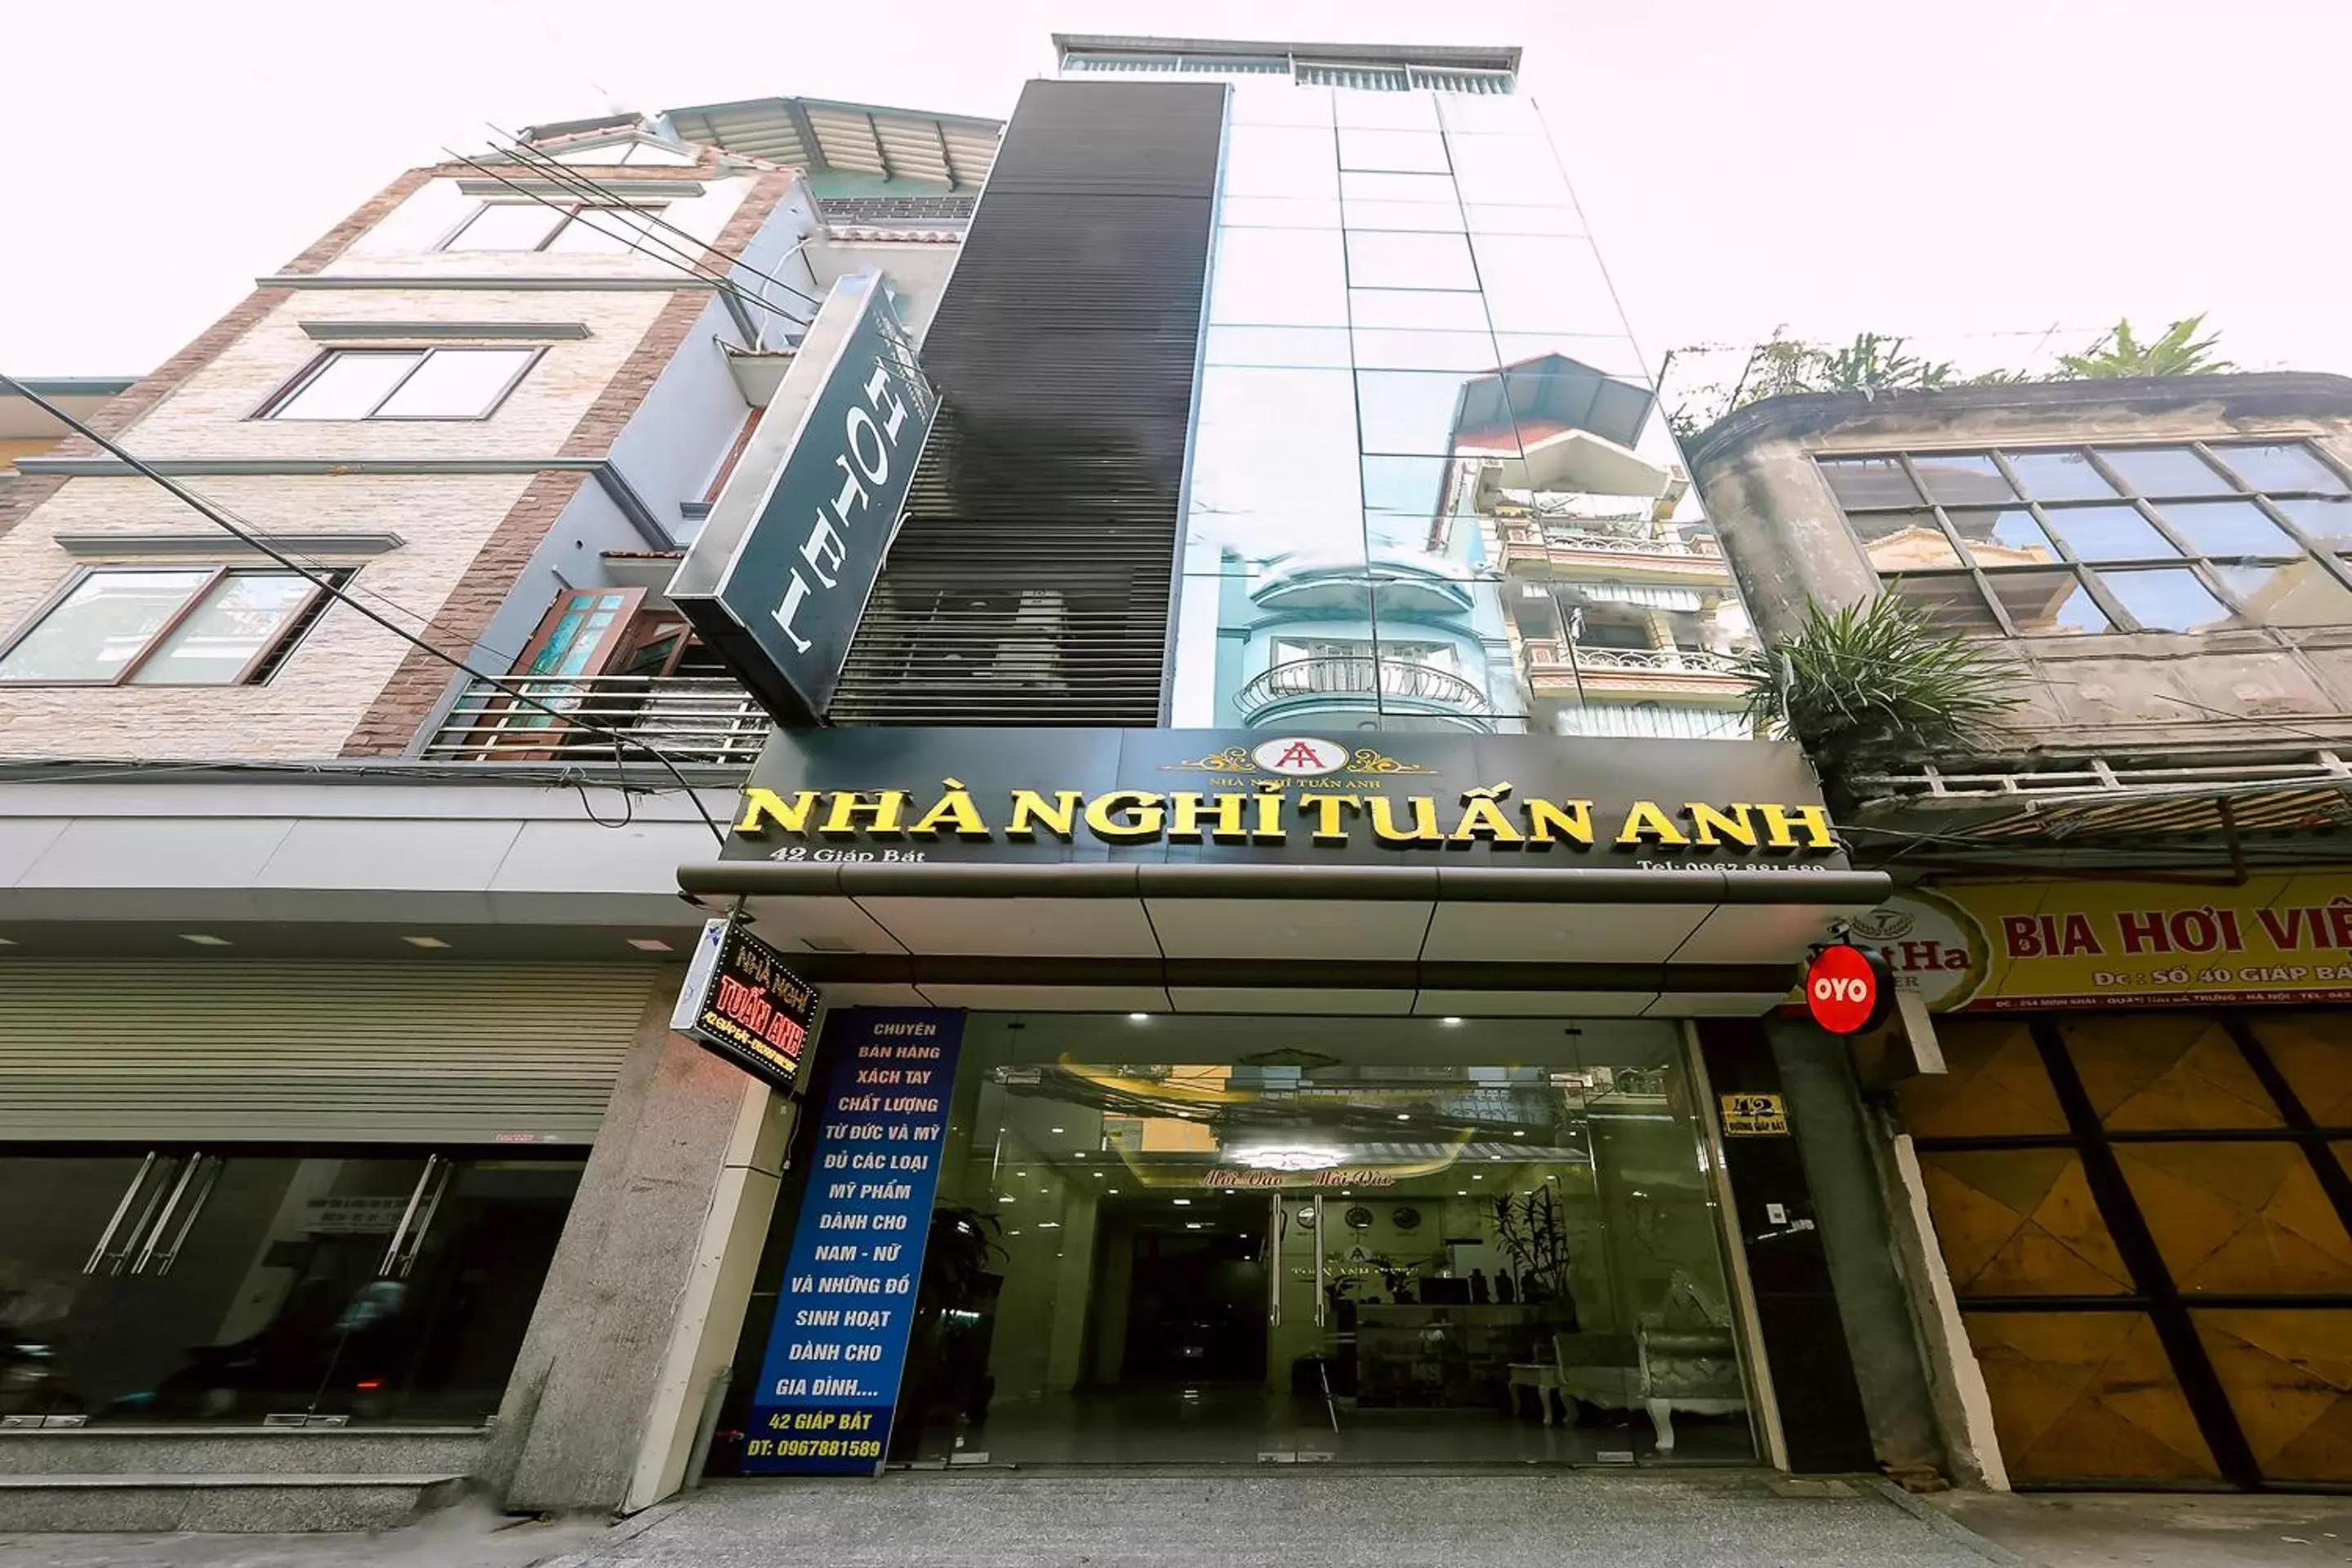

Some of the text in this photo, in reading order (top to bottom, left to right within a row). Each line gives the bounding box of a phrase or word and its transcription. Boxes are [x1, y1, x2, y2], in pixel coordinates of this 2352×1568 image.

[772, 354, 907, 654] HOTEL
[1209, 778, 1244, 787] NHÀ
[1297, 777, 1342, 788] TUẤN
[1345, 781, 1381, 789] ANH
[733, 777, 1841, 854] NHÀ NGHỈ TUẤN ANH
[769, 847, 807, 862] 42
[813, 849, 874, 862] Giáp
[1998, 911, 2106, 959] BIA
[2114, 905, 2246, 956] HƠI
[2152, 964, 2189, 985] SỐ
[2198, 969, 2231, 984] 40
[2239, 965, 2307, 982] GIÁP
[1815, 978, 1867, 1002] OYO
[716, 975, 772, 1036] TUẤN
[765, 1012, 804, 1057] ANH
[873, 1022, 936, 1036] CHUYÊN
[858, 1045, 941, 1058] BÁN HÀNG
[856, 1067, 931, 1085] XÁCH TAY
[838, 1093, 938, 1115] CHẤT LƯỢNG
[1732, 1098, 1775, 1116] 42
[826, 1121, 941, 1141] TỪ ĐỨC VÀ MỸ
[824, 1150, 929, 1173] ĐỦ CÁC LOẠI
[829, 1182, 856, 1199] MỸ
[819, 1212, 907, 1230] DÀNH CHO
[815, 1245, 857, 1261] NAM
[873, 1243, 902, 1261] NỮ
[791, 1274, 813, 1293] VÀ
[817, 1274, 880, 1294] NHỮNG
[795, 1310, 891, 1330] SINH HOẠT
[789, 1340, 881, 1361] DÀNH CHO
[776, 1379, 807, 1396] GIA
[768, 1411, 873, 1430] 42 GIÁP BÁT
[777, 1441, 880, 1457] 0967881589
